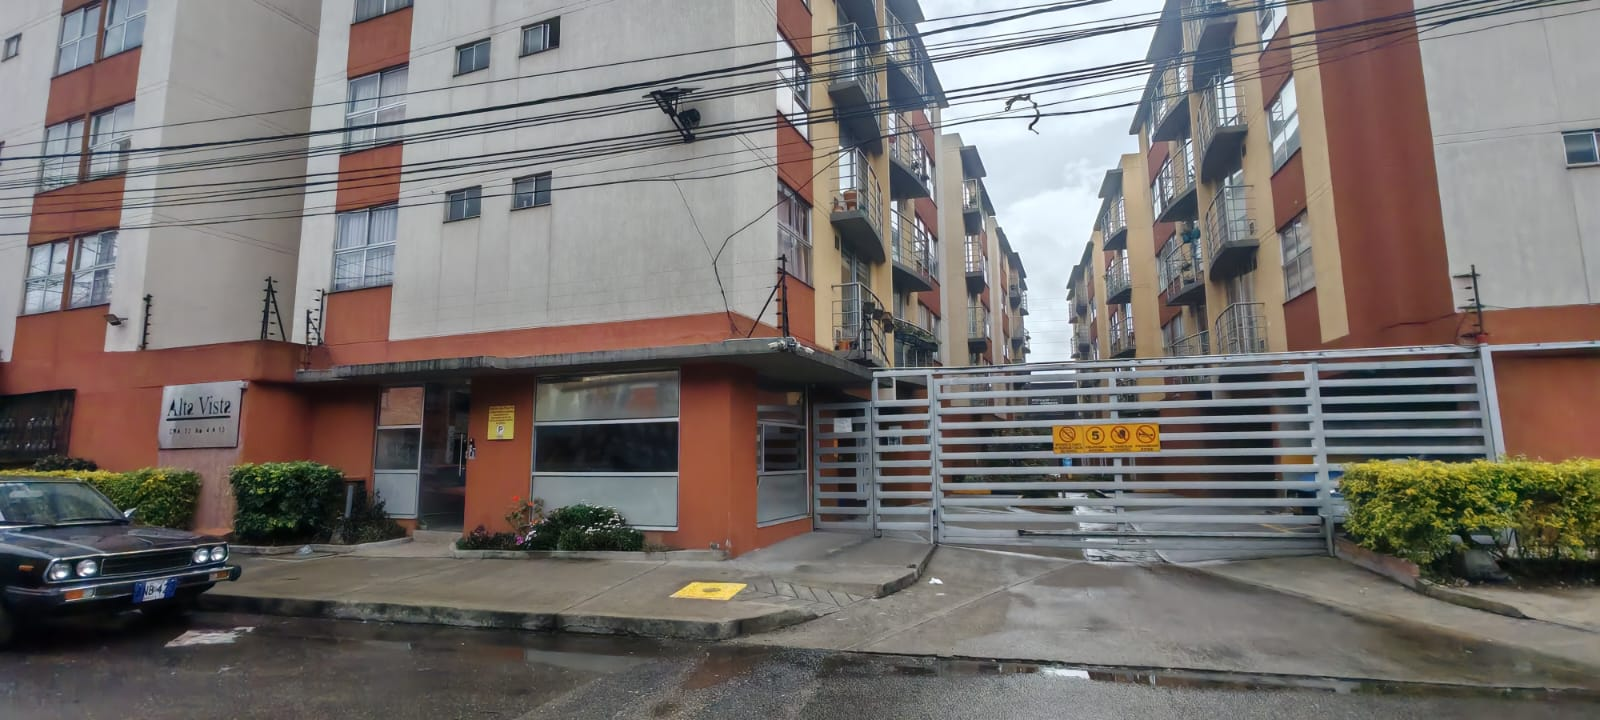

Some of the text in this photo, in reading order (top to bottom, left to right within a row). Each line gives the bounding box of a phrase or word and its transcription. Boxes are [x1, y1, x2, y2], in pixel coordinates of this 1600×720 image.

[167, 395, 231, 417] Alta Vista
[1091, 431, 1100, 440] 5
